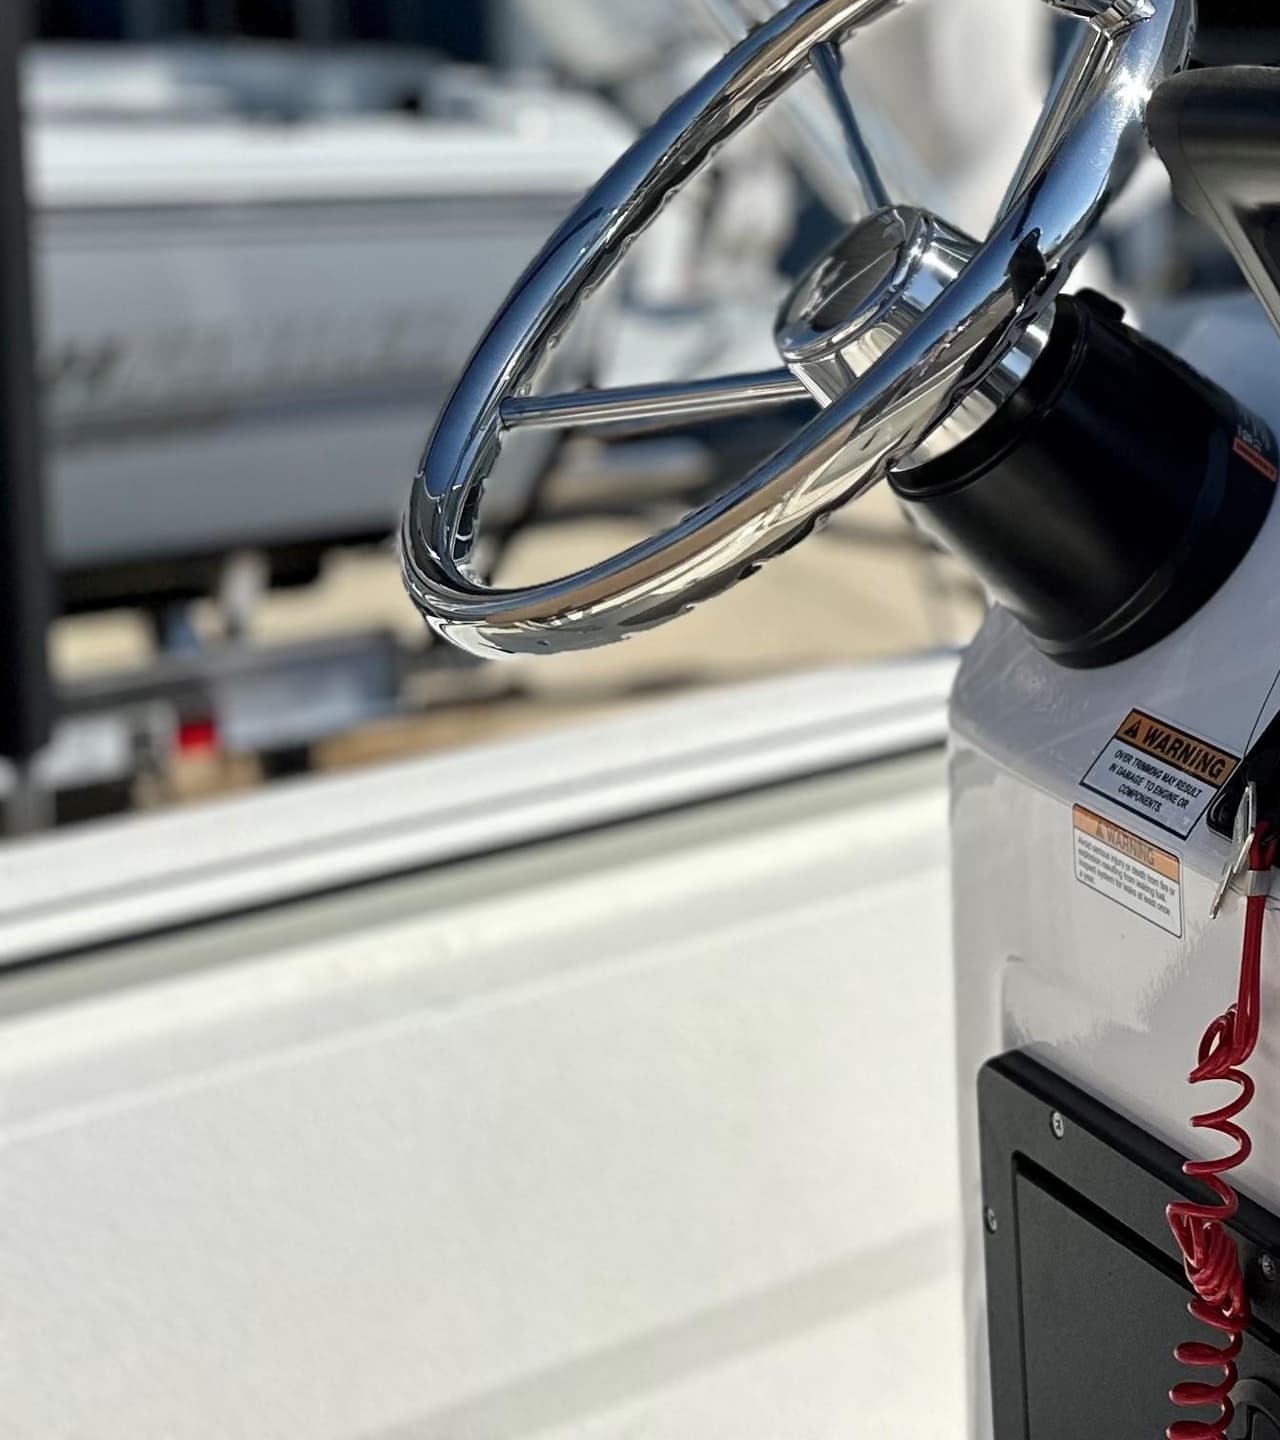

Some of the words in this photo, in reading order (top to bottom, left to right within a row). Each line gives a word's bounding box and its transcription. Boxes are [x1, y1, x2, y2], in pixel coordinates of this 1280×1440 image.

[1114, 749, 1134, 764] OVER
[1161, 772, 1178, 785] MAY
[1175, 779, 1203, 798] RESULT
[1142, 725, 1226, 780] WARNING
[1108, 762, 1118, 772] IN
[1116, 766, 1145, 786] DAMAGE
[1144, 780, 1155, 792] TO
[1153, 785, 1179, 804] ENGINE
[1177, 797, 1189, 809] OR
[1103, 824, 1155, 866] WARNING
